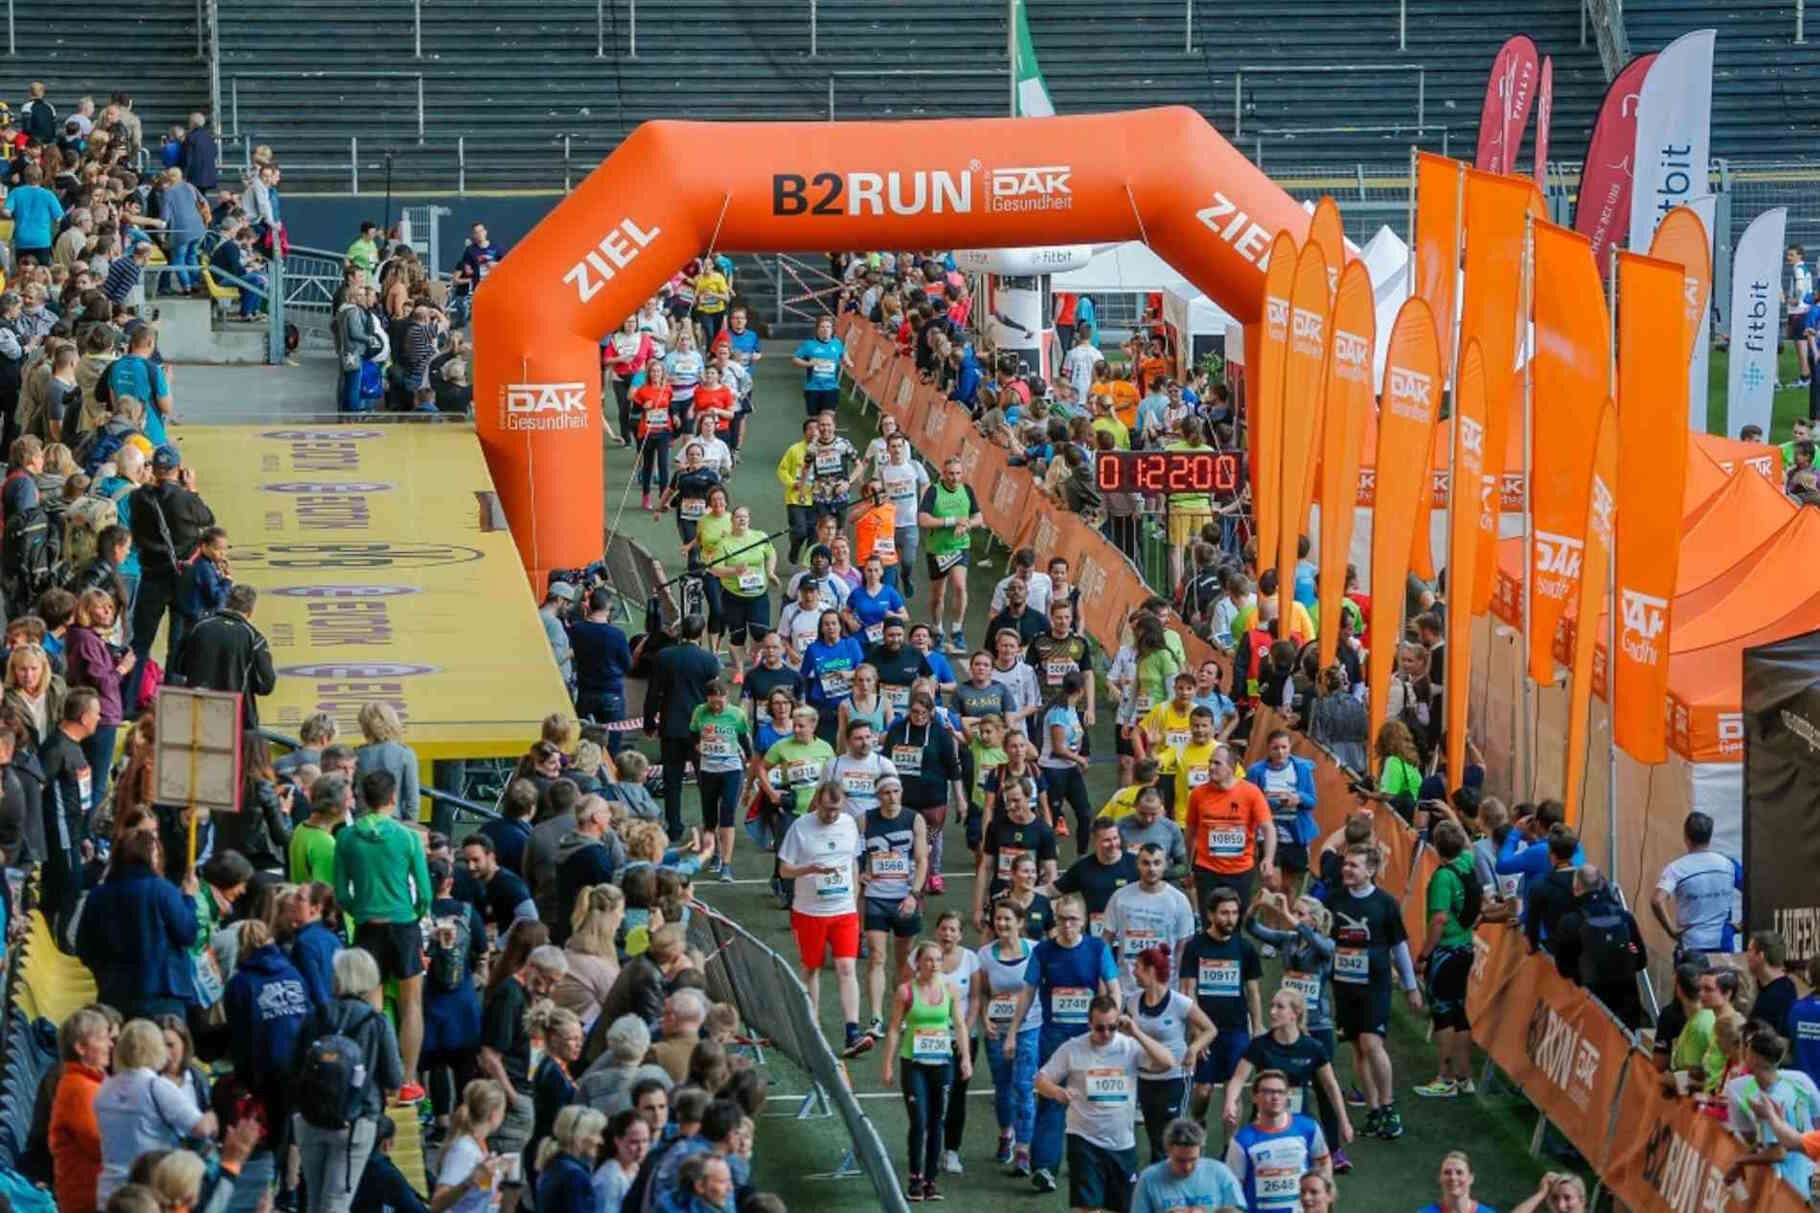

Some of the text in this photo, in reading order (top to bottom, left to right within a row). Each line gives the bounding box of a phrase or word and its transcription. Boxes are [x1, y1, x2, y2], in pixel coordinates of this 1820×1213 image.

[992, 166, 1071, 196] DAK
[992, 195, 1072, 213] Gesundheit
[562, 217, 660, 303] ZIEL
[1043, 250, 1072, 264] fitbit
[1745, 280, 1770, 352] fitbit
[507, 383, 586, 412] DAK
[1391, 367, 1431, 405] DAK
[508, 412, 588, 431] Gesundheit
[1203, 969, 1238, 983] 10917
